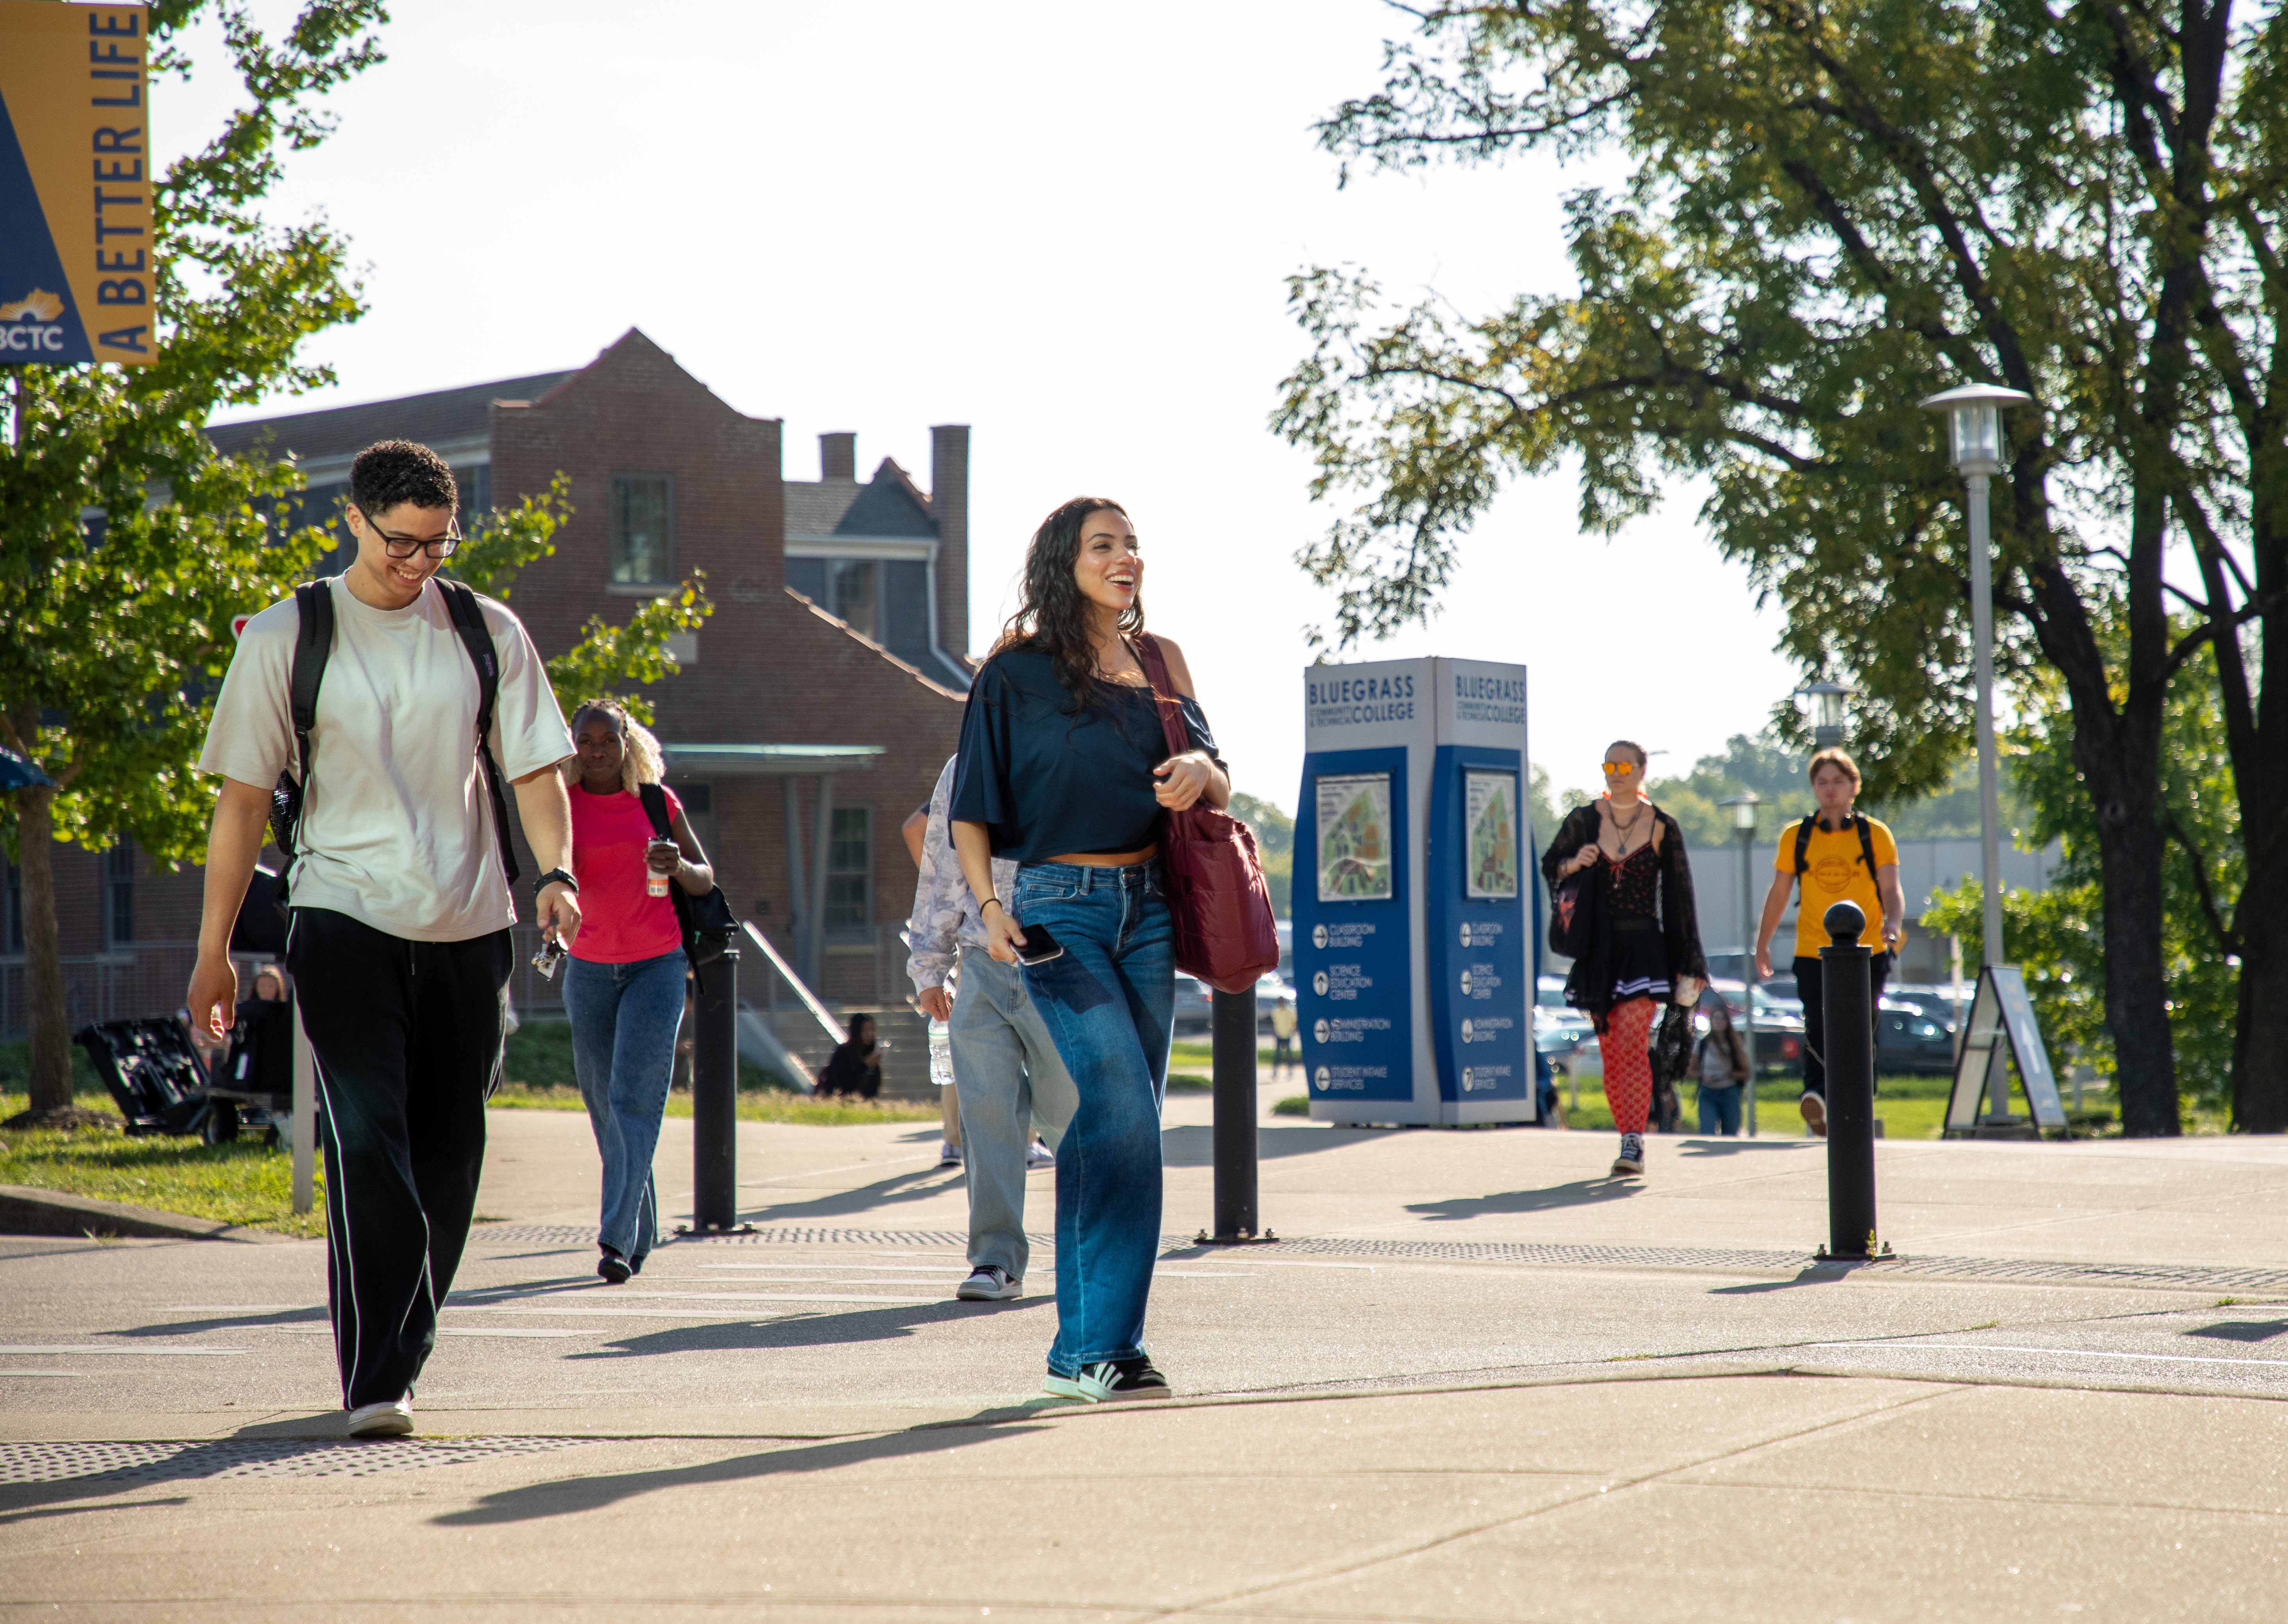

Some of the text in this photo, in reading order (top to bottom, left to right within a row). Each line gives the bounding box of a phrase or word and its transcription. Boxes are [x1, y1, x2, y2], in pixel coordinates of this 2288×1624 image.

[88, 13, 148, 354] A BETTER LIFE
[1309, 674, 1414, 705] BLUEGRASS
[1456, 675, 1525, 702] BLUEGRASS
[1352, 701, 1414, 724] COLLEGE
[1486, 703, 1525, 724] COLLEGE
[1328, 935, 1363, 947] BUILDING
[1330, 976, 1373, 988] EDUCATION
[1329, 988, 1358, 1000] CENTER
